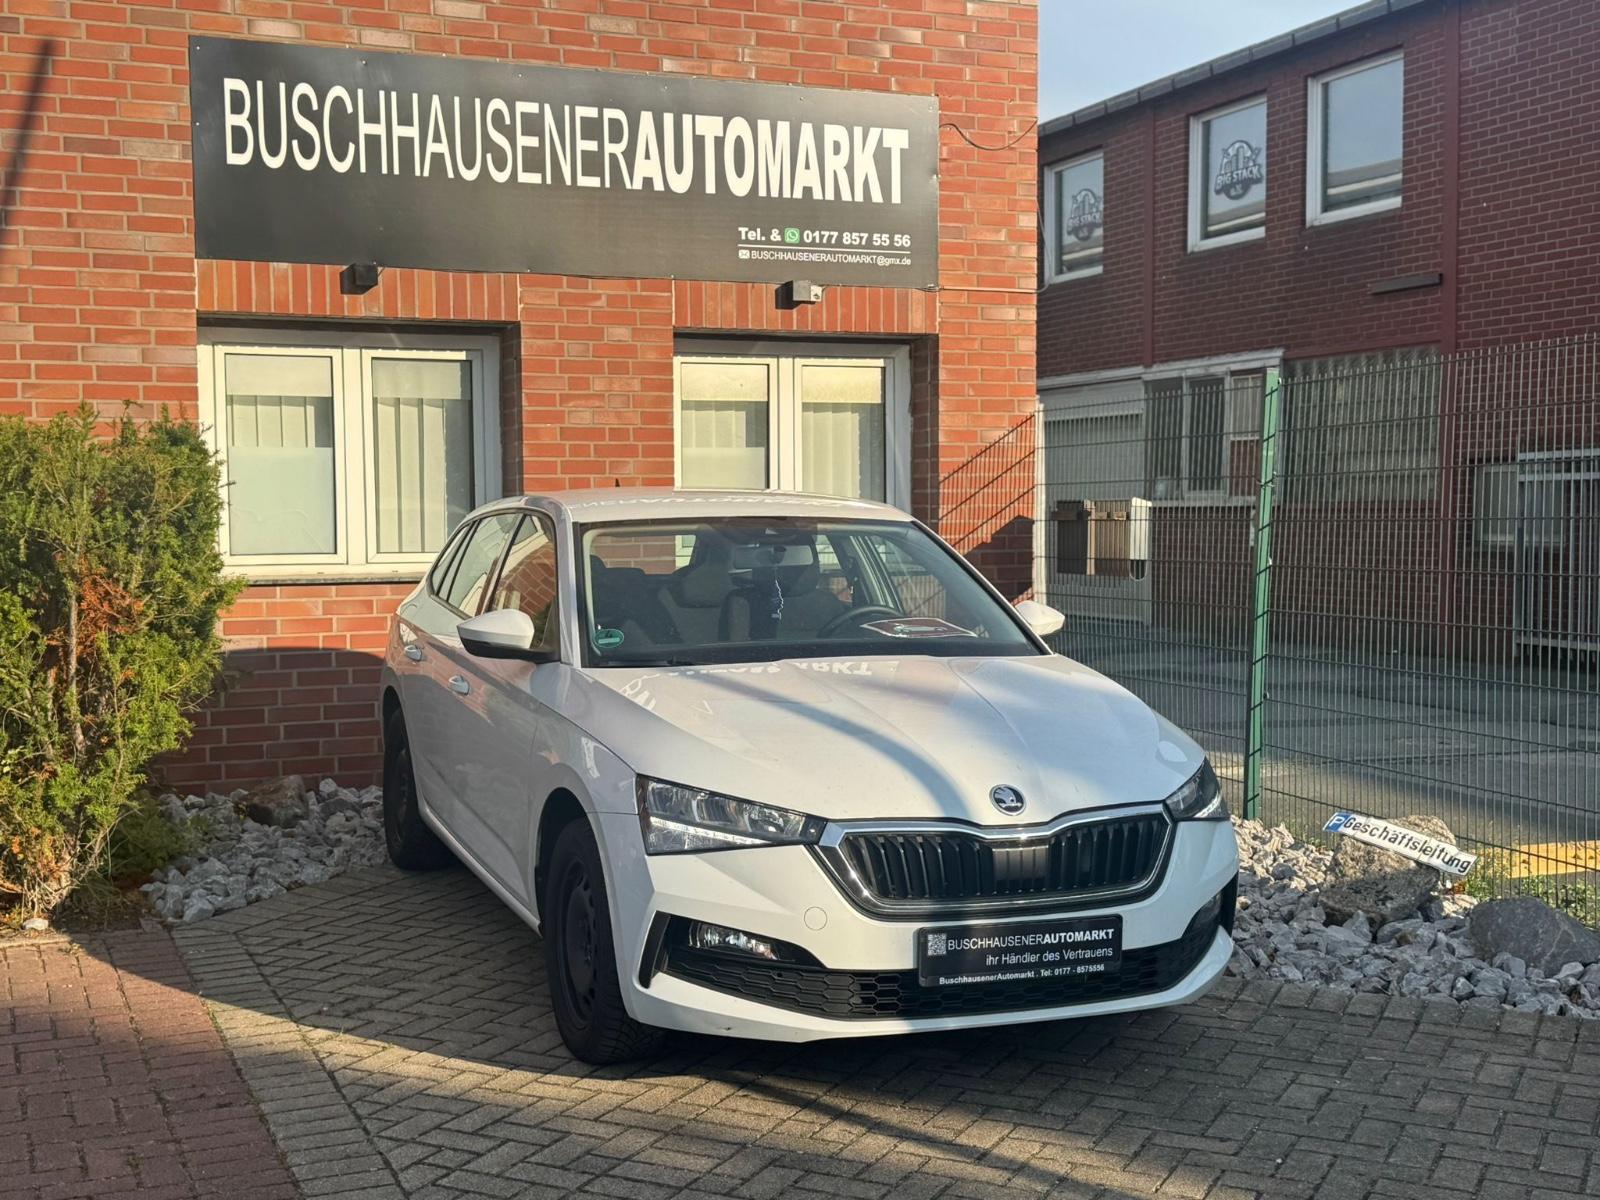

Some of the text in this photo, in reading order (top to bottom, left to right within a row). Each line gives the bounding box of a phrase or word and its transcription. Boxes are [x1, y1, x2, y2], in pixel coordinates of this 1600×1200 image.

[222, 77, 909, 204] BUSCHHAUSENERAUTOMARKT
[1232, 165, 1261, 182] STACK
[738, 226, 912, 247] Tel. & 0177 857 55 56
[751, 250, 911, 266] BUSCHHAUSENERAUTOMARKT@gmx.de
[1343, 817, 1471, 873] Geschäftsleitung
[948, 929, 1114, 950] BUSCHHAUSENERAUTOMARKT
[986, 947, 1113, 966] ihr Händler des Vertrauens
[939, 970, 1035, 985] BuschhausenerAutomarkt
[1054, 967, 1071, 976] 0177
